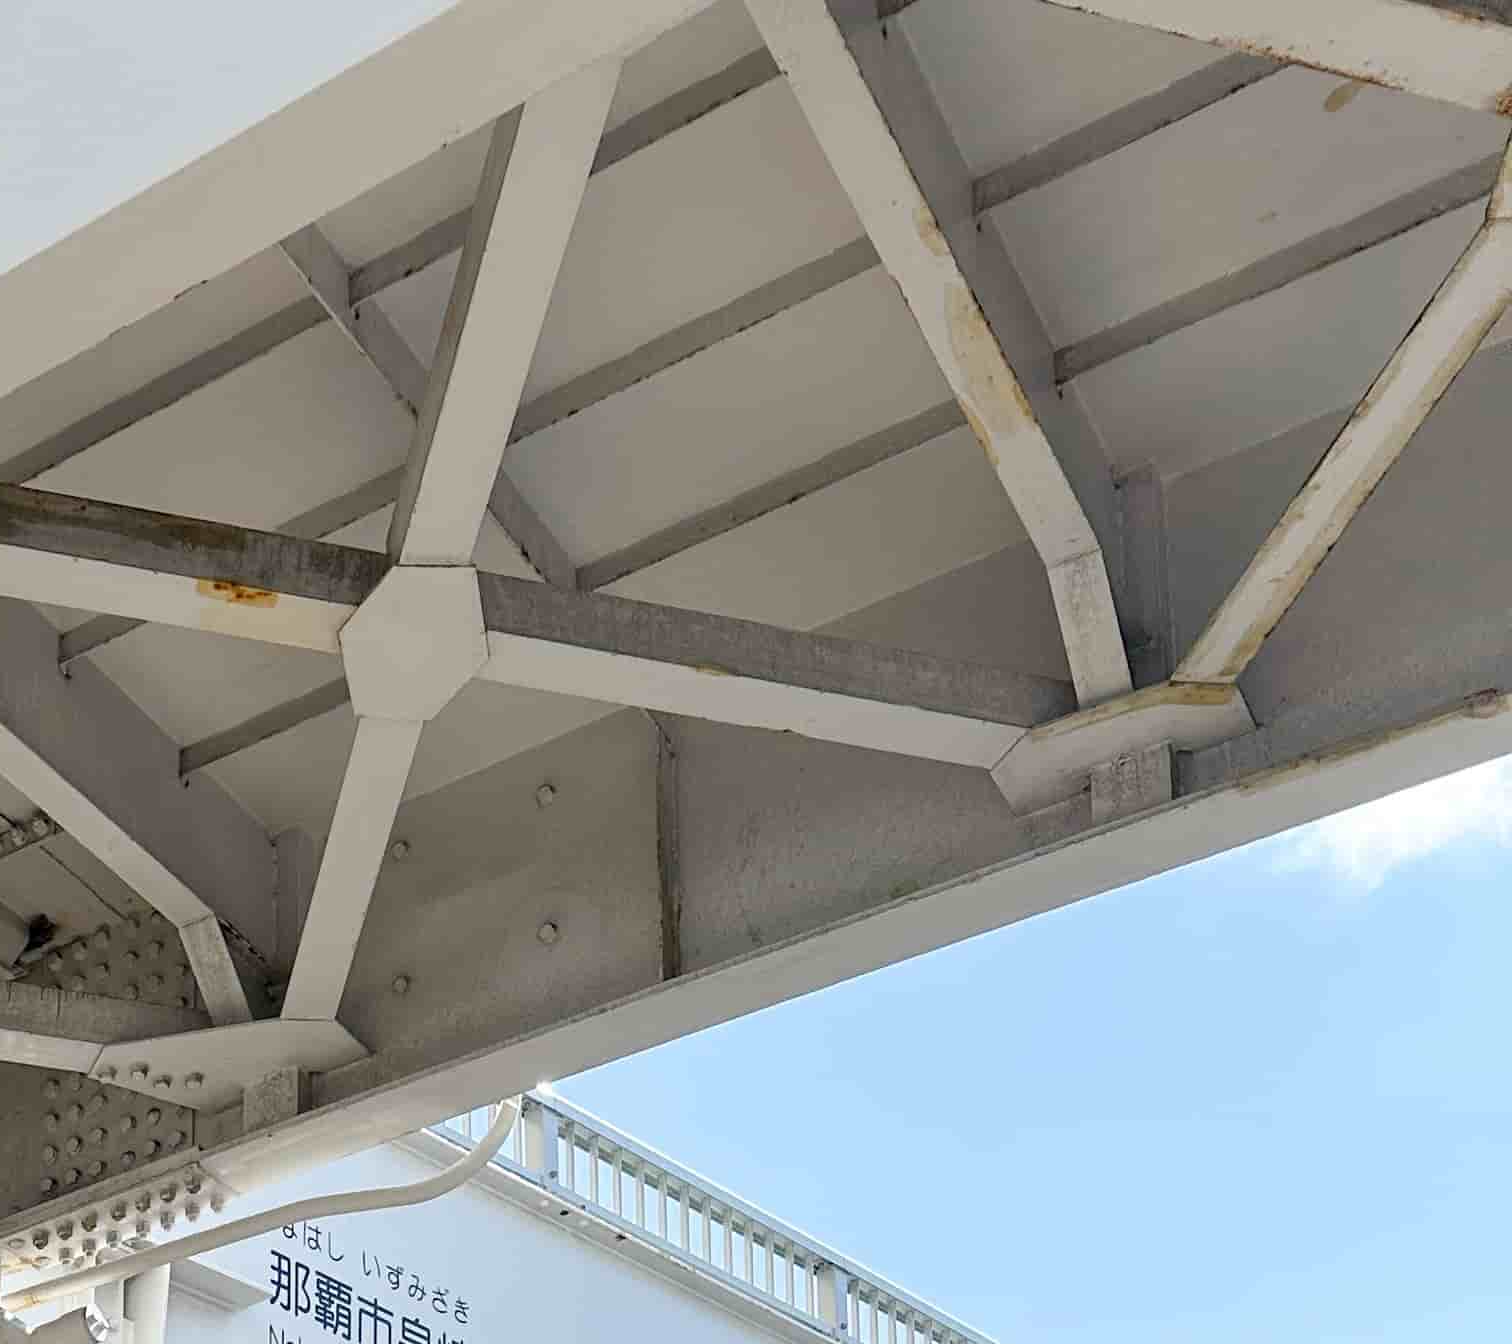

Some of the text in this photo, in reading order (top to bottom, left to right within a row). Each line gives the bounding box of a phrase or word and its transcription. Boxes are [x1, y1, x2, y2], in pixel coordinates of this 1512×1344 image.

[362, 1250, 471, 1324] いずみざき
